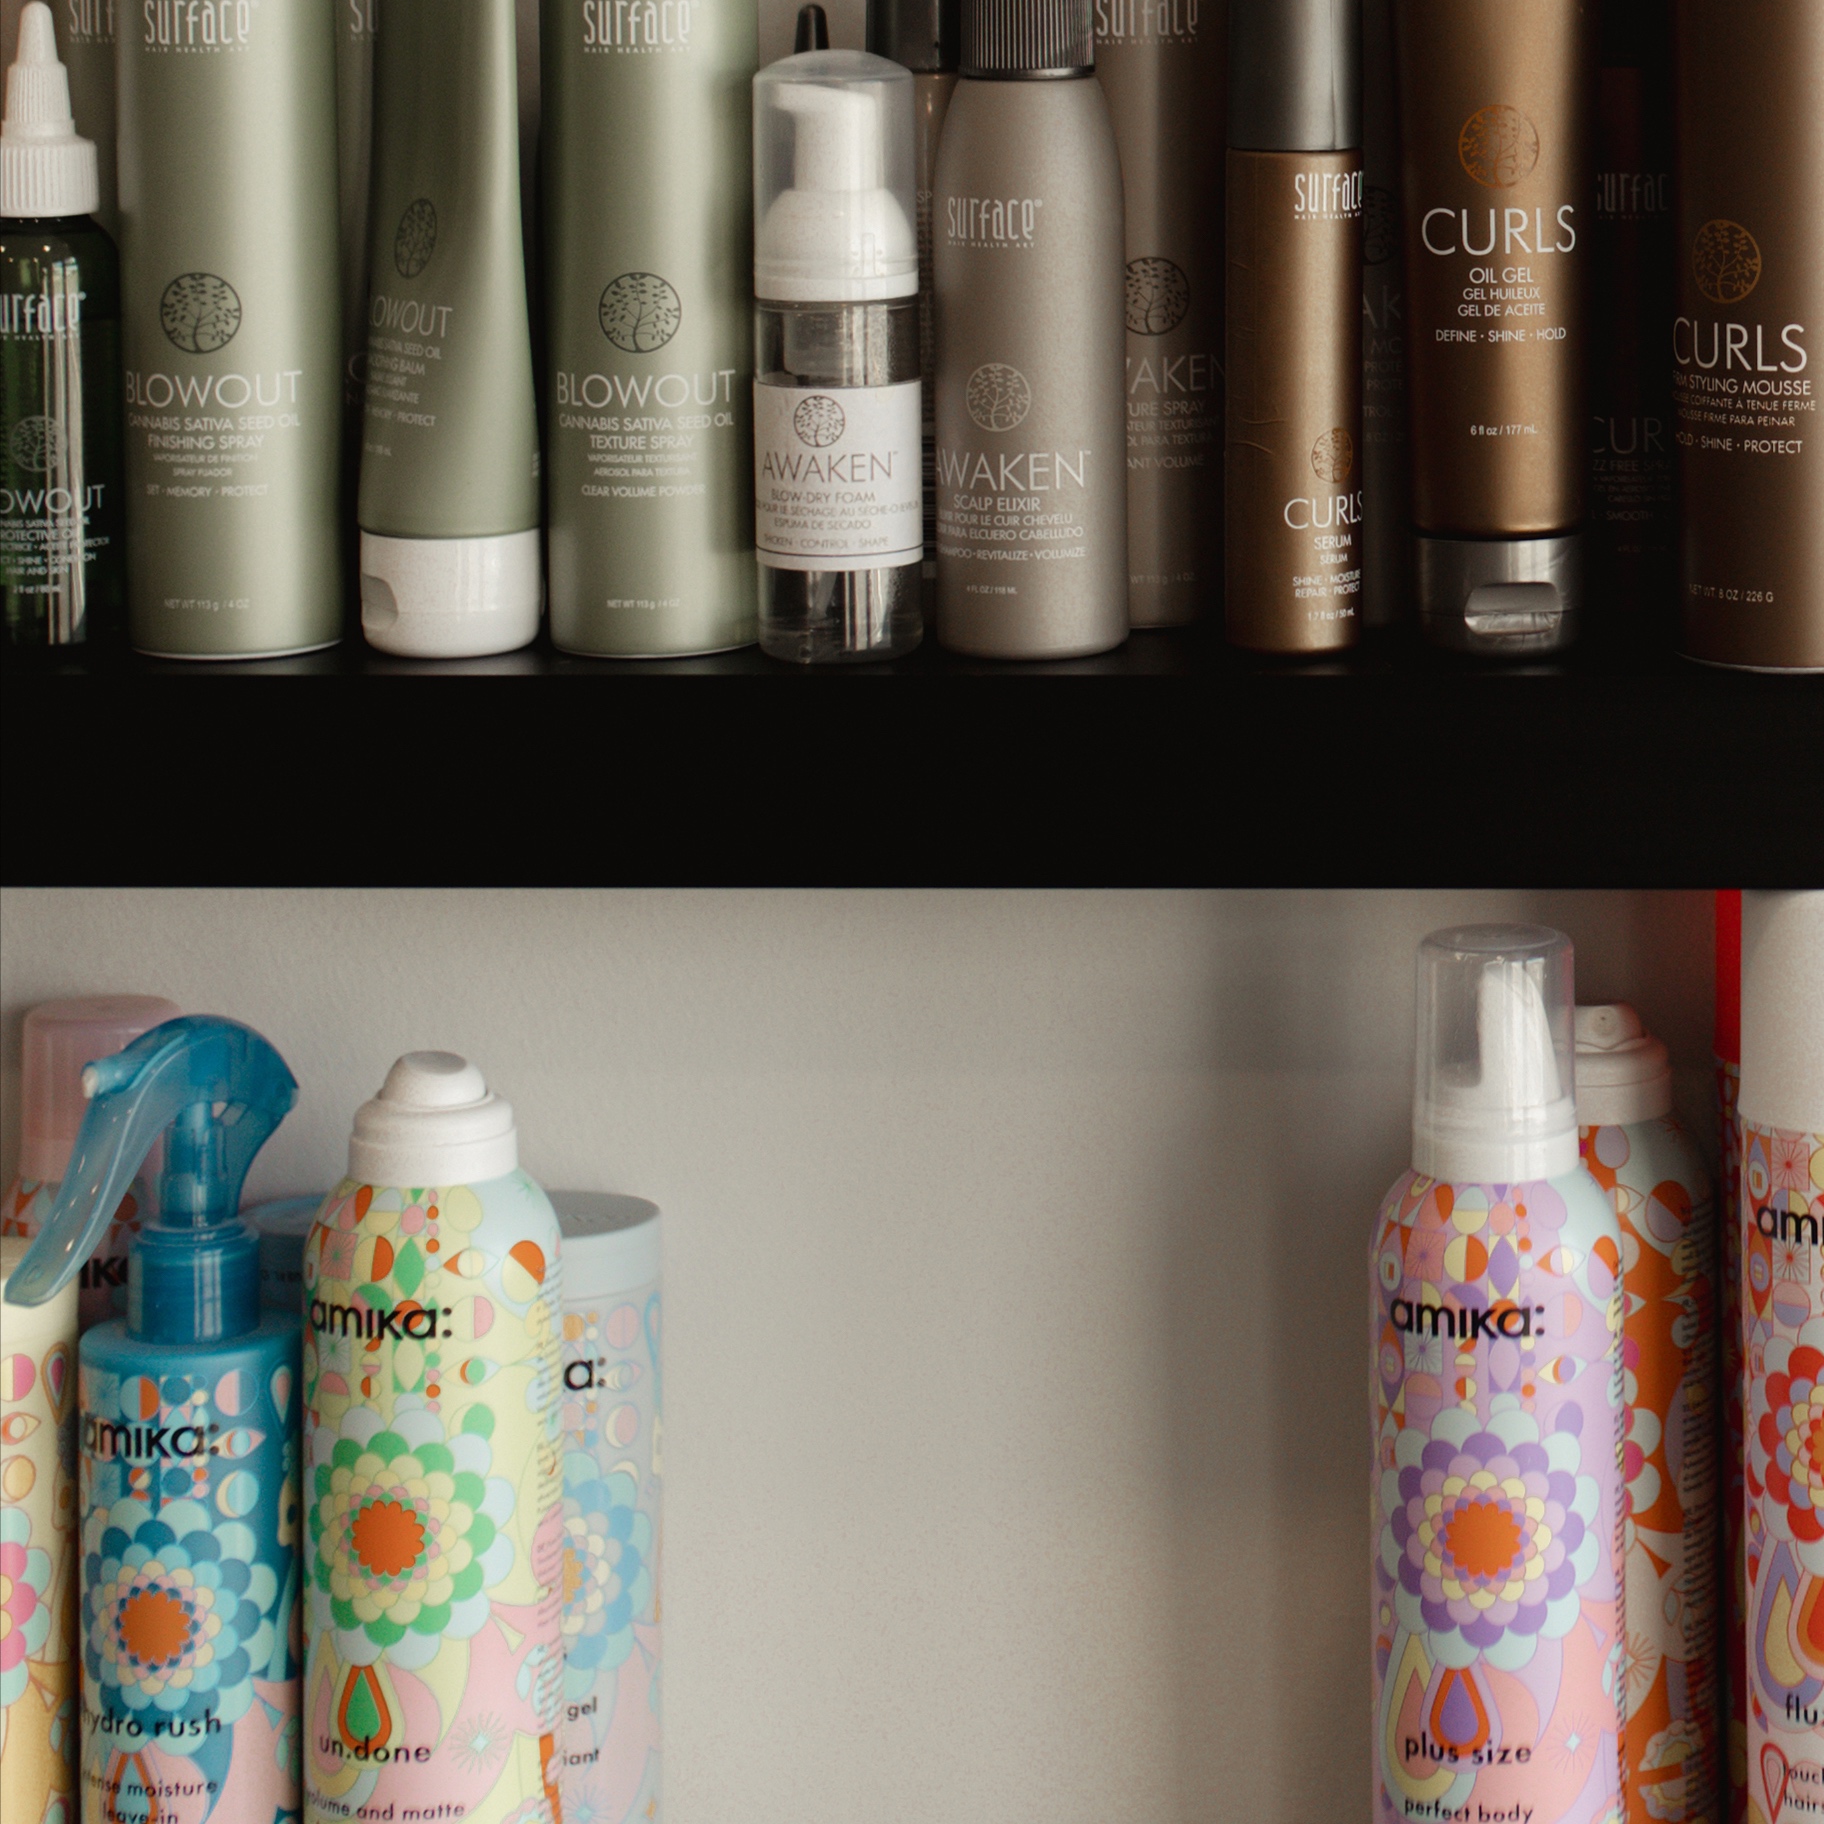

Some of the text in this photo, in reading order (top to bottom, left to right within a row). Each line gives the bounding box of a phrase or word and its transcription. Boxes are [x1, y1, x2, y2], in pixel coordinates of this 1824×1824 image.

[144, 0, 250, 45] surface
[583, 0, 691, 45] surface
[617, 46, 663, 54] HEALTH
[948, 196, 1034, 240] surface
[1421, 204, 1576, 256] CURLS
[1469, 267, 1534, 284] OIL GEL
[1462, 287, 1541, 301] GEL HUILEUX
[1457, 303, 1546, 317] GEL DE ACEITE
[1435, 327, 1567, 343] DEFINE SHINE HOLD
[1673, 316, 1808, 373] CURLS
[1126, 354, 1225, 395] AKEN
[125, 370, 303, 409] BLOWOUT
[557, 369, 736, 409] BLOWOUT
[1689, 374, 1812, 396] STYLING MOUSSE
[1690, 394, 1733, 410] COIFFANTE
[1746, 399, 1779, 411] TENUE
[1782, 400, 1816, 411] FERME
[128, 412, 302, 432] CANNABIS SATIVA SEED OIL
[559, 412, 735, 432] CANNABIS SATIVA SEED OIL
[1470, 423, 1522, 436] 6 oz 177
[1729, 414, 1796, 427] PARA PEINAR
[147, 433, 265, 451] FINISHING SPRAY
[589, 434, 695, 450] TEXTURE SPRAY
[1700, 435, 1803, 454] SHINE PROTECT
[762, 450, 892, 483] AWAKEN
[166, 484, 269, 498] MEMORY PROTECT
[581, 484, 656, 498] CLEAR VOLUME
[771, 487, 876, 504] BLOW-DRY FOAM
[953, 494, 1041, 512] SCALP ELIXIR
[1283, 490, 1363, 530] CURLS
[981, 514, 1073, 526] LE CUIR CHEVELU
[1019, 527, 1084, 541] CABELLUDO
[1314, 534, 1352, 550] SERUM
[976, 549, 1029, 561] REVITALIZE
[1292, 576, 1322, 587] SHINE
[1294, 587, 1328, 598] REPAIR
[1725, 588, 1774, 603] OZ 226 G
[309, 1297, 453, 1341] amika:
[1390, 1296, 1545, 1339] amika:
[566, 1695, 598, 1722] gel
[155, 1708, 221, 1738] rush
[318, 1735, 431, 1764] un.done
[1405, 1730, 1532, 1766] plus size
[127, 1780, 218, 1798] moisture
[356, 1799, 394, 1822] and
[402, 1798, 465, 1822] matte
[1404, 1795, 1533, 1824] perfect body
